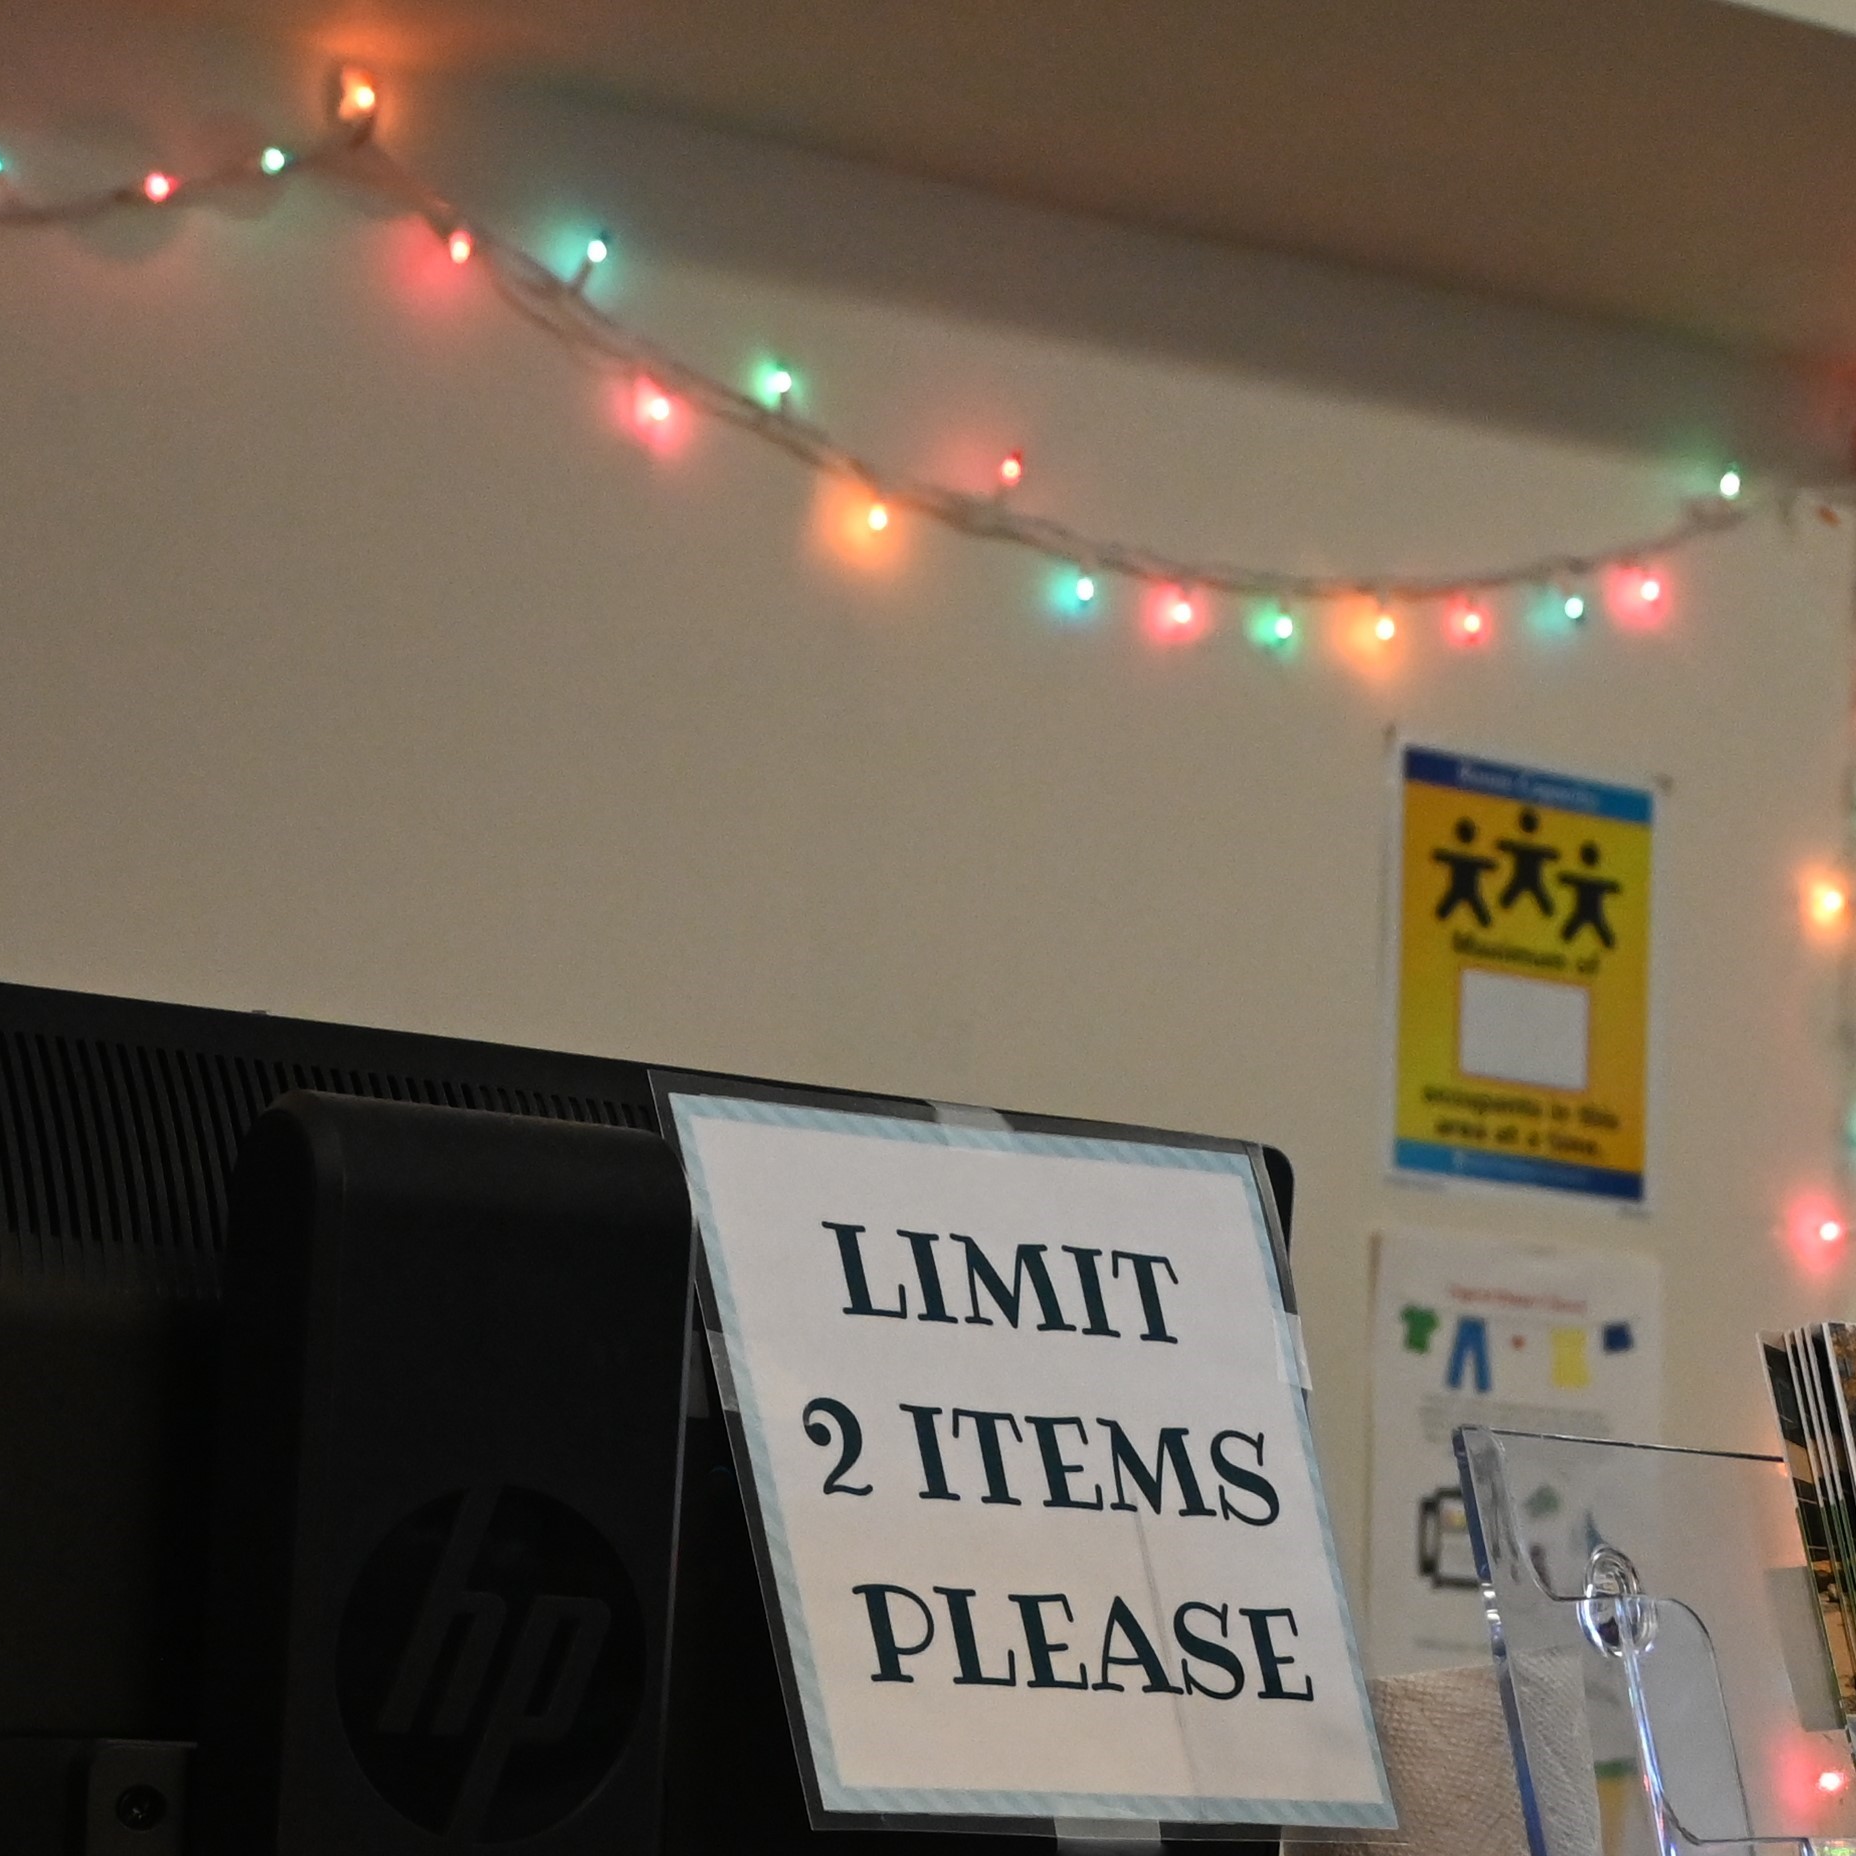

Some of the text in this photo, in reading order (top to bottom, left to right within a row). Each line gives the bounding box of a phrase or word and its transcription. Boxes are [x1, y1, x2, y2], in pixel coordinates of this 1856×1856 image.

[821, 1221, 1178, 1344] LIMIT
[803, 1397, 1280, 1527] 2 ITEMS
[376, 1484, 612, 1837] hp
[852, 1583, 1314, 1701] PLEASE
